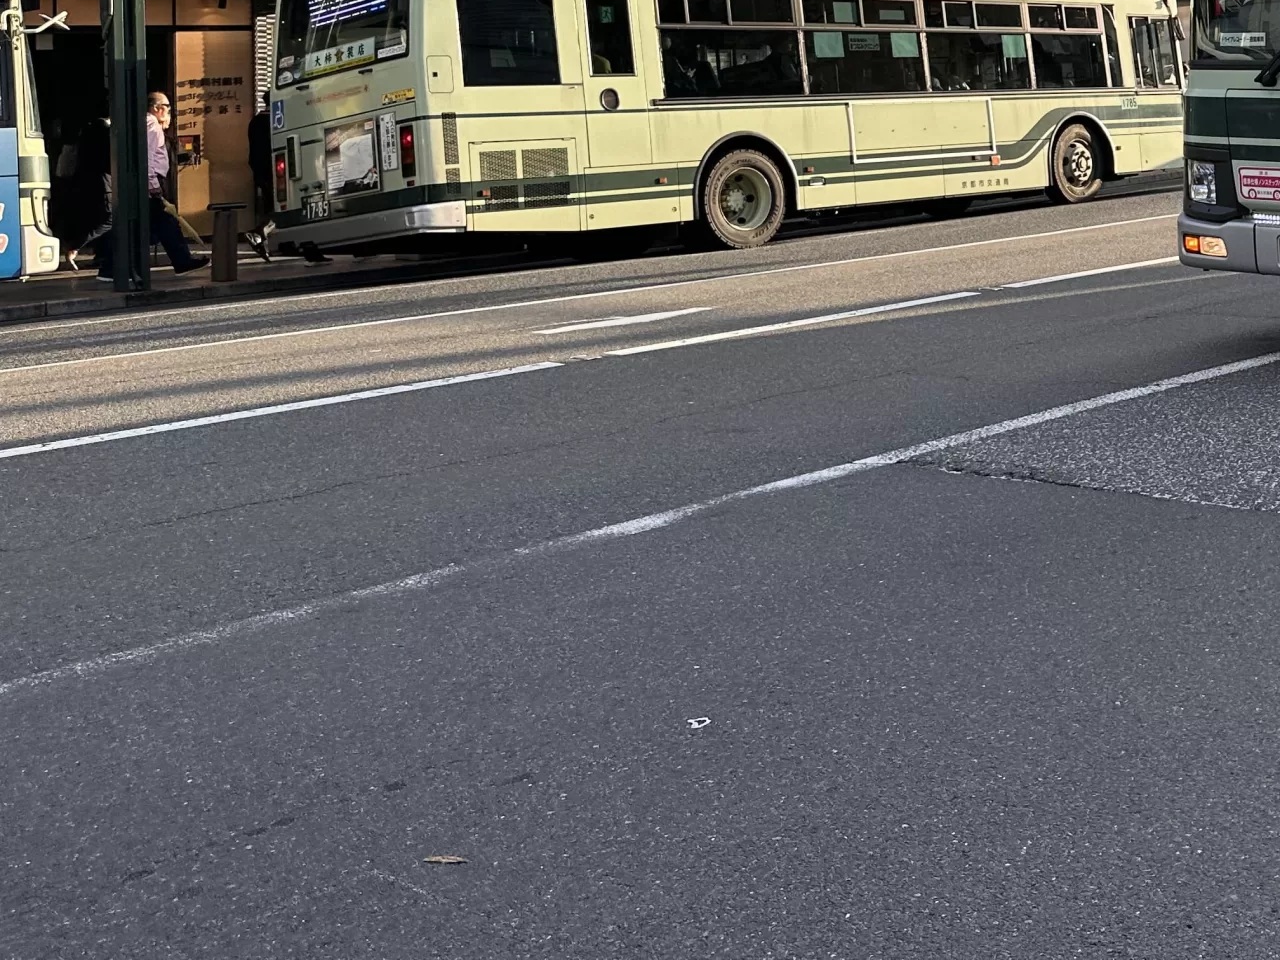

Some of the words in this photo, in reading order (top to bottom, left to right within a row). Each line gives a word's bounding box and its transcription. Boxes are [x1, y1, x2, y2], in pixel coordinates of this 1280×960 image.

[1122, 97, 1137, 108] 1785
[961, 177, 1010, 189] 京都市交通局
